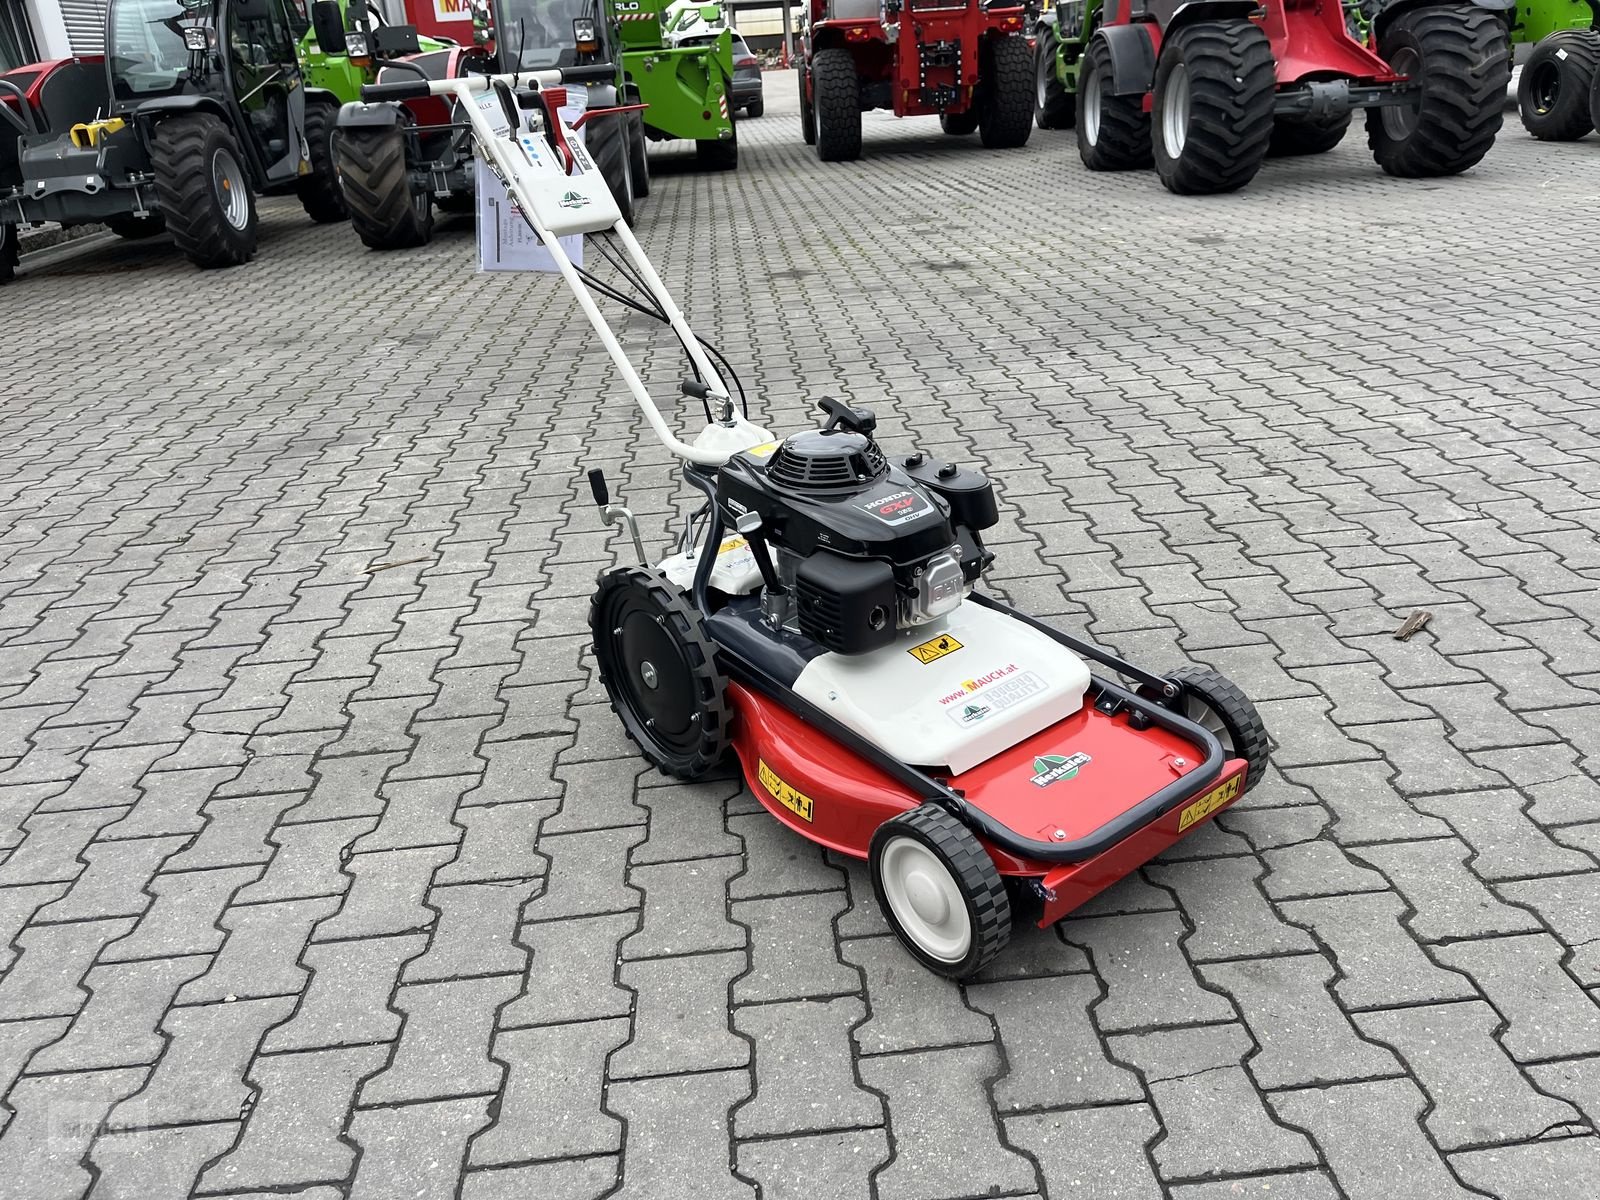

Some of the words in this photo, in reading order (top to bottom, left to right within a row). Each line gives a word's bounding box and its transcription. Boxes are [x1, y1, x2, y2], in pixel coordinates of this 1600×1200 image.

[864, 491, 912, 510] HONDA
[879, 496, 915, 514] GXV
[904, 512, 920, 521] OHV
[939, 663, 1019, 705] www.MAUCH.at
[1032, 753, 1090, 787] Herkules
